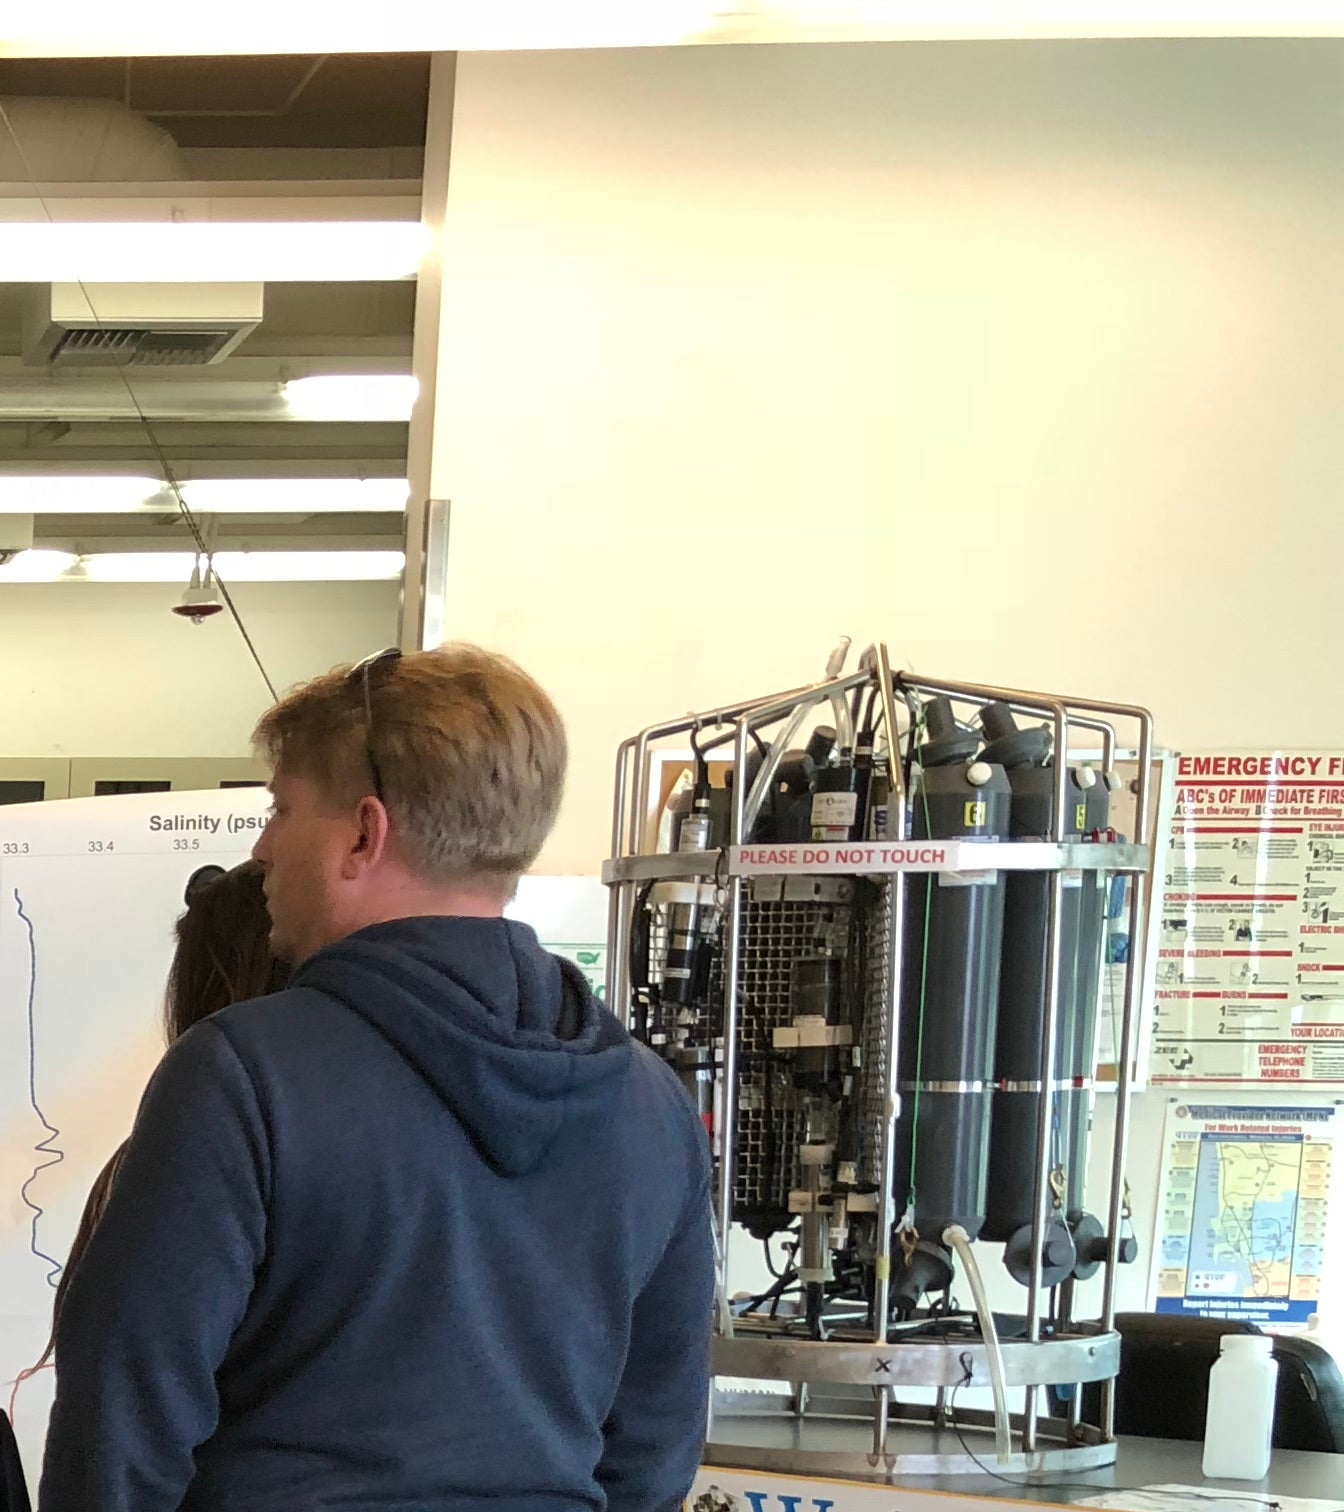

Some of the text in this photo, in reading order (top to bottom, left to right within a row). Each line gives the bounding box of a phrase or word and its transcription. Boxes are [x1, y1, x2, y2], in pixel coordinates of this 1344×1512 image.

[1178, 757, 1321, 775] EMERGENCY
[1176, 789, 1214, 803] ABC's
[1219, 789, 1236, 803] OF
[1240, 789, 1314, 803] IMMEDIATE
[1206, 806, 1219, 815] the
[1221, 806, 1249, 817] Airway
[149, 814, 220, 833] Salinity
[3, 839, 199, 854] 33.3 33.4 33.5
[1232, 838, 1239, 849] 2
[740, 849, 944, 864] PLEASE DO NOT TOUCH
[1229, 874, 1238, 885] 4
[1258, 1044, 1307, 1054] EMERGENCY
[1259, 1057, 1305, 1066] TELEPHONE
[1261, 1069, 1300, 1078] NUMBERS
